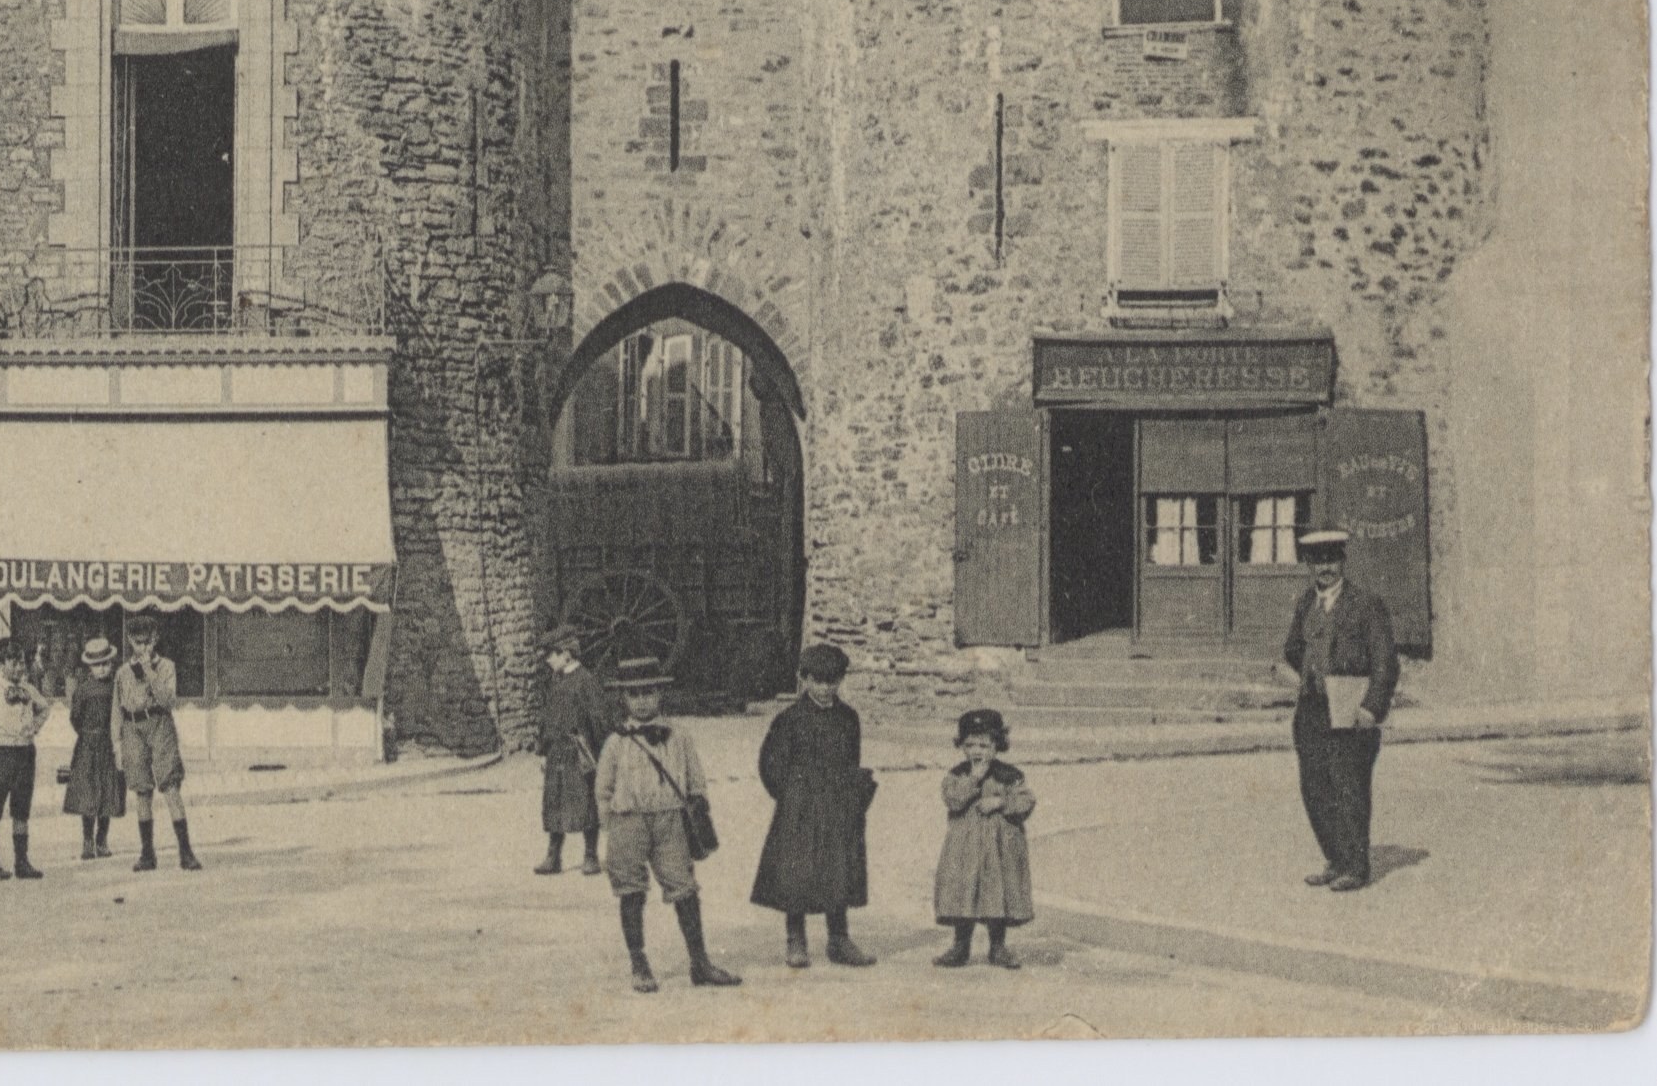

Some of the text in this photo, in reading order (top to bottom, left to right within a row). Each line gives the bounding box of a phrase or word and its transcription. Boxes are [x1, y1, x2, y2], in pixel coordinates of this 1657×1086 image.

[1052, 366, 1310, 389] BEUCHERESSE
[968, 453, 1033, 476] CIDRE
[186, 562, 373, 593] PATISSERIE
